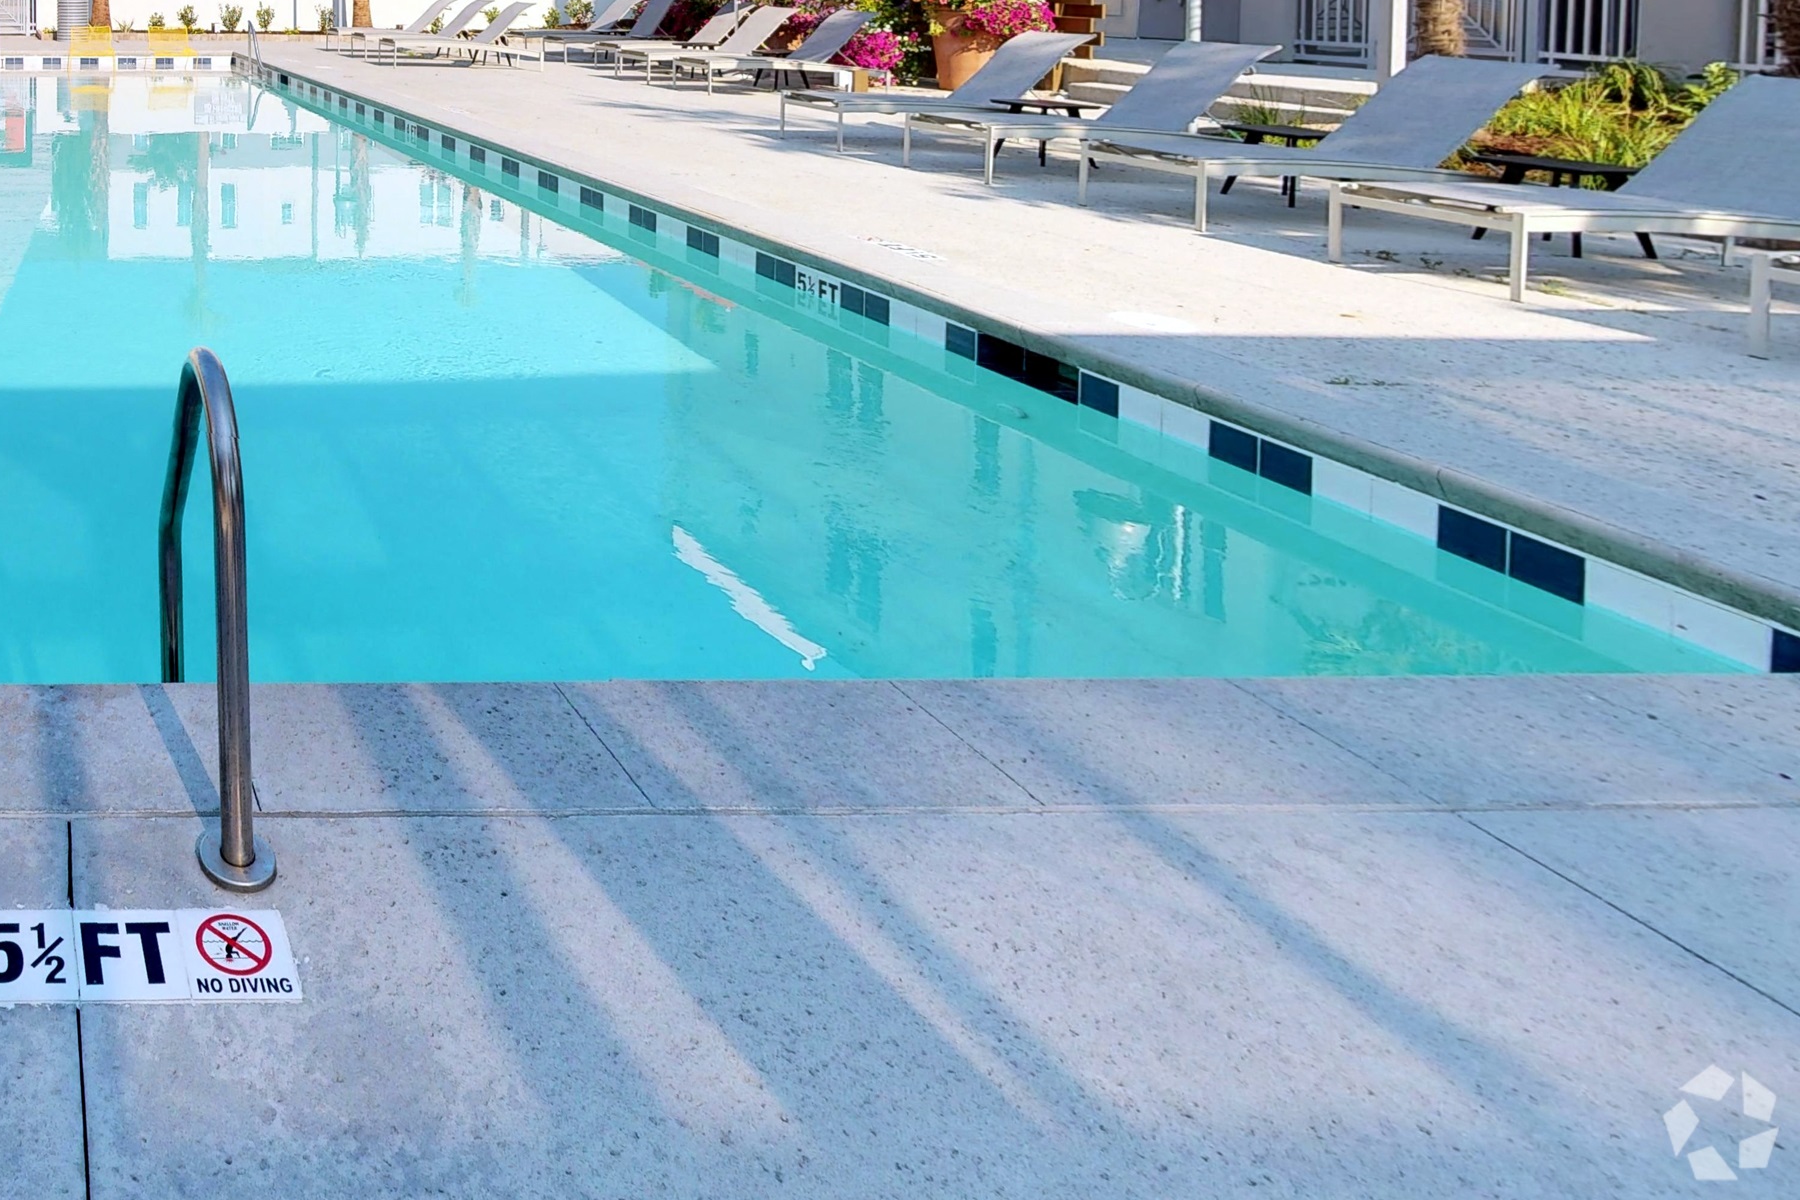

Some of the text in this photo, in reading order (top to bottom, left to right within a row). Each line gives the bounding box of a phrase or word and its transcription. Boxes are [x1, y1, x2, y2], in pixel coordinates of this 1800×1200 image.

[818, 279, 838, 304] FT
[79, 921, 171, 986] FT
[197, 978, 293, 994] NO DIVING
